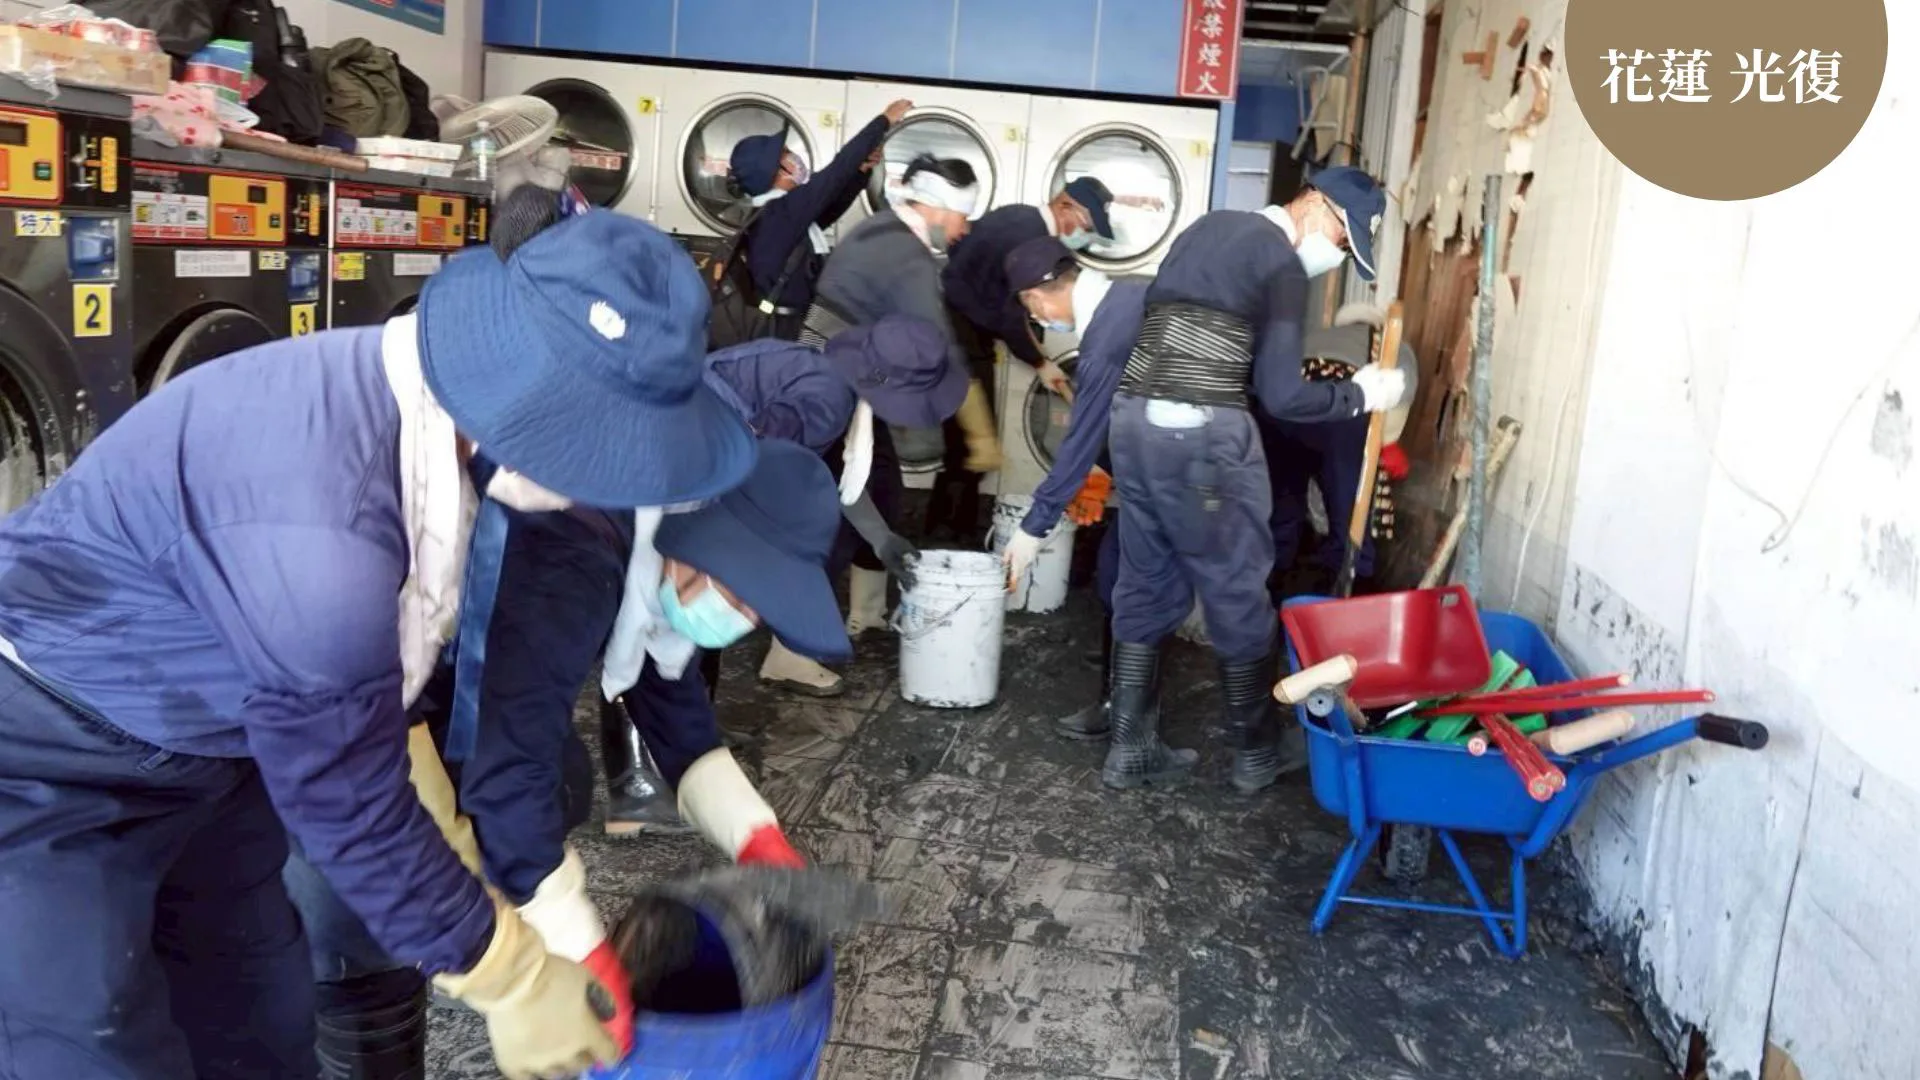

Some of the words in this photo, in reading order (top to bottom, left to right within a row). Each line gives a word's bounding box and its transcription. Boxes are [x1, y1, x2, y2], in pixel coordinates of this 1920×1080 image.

[823, 113, 833, 127] 5
[1007, 128, 1017, 142] 3
[20, 213, 58, 235] 特大
[85, 293, 102, 329] 2
[298, 311, 309, 335] 3
